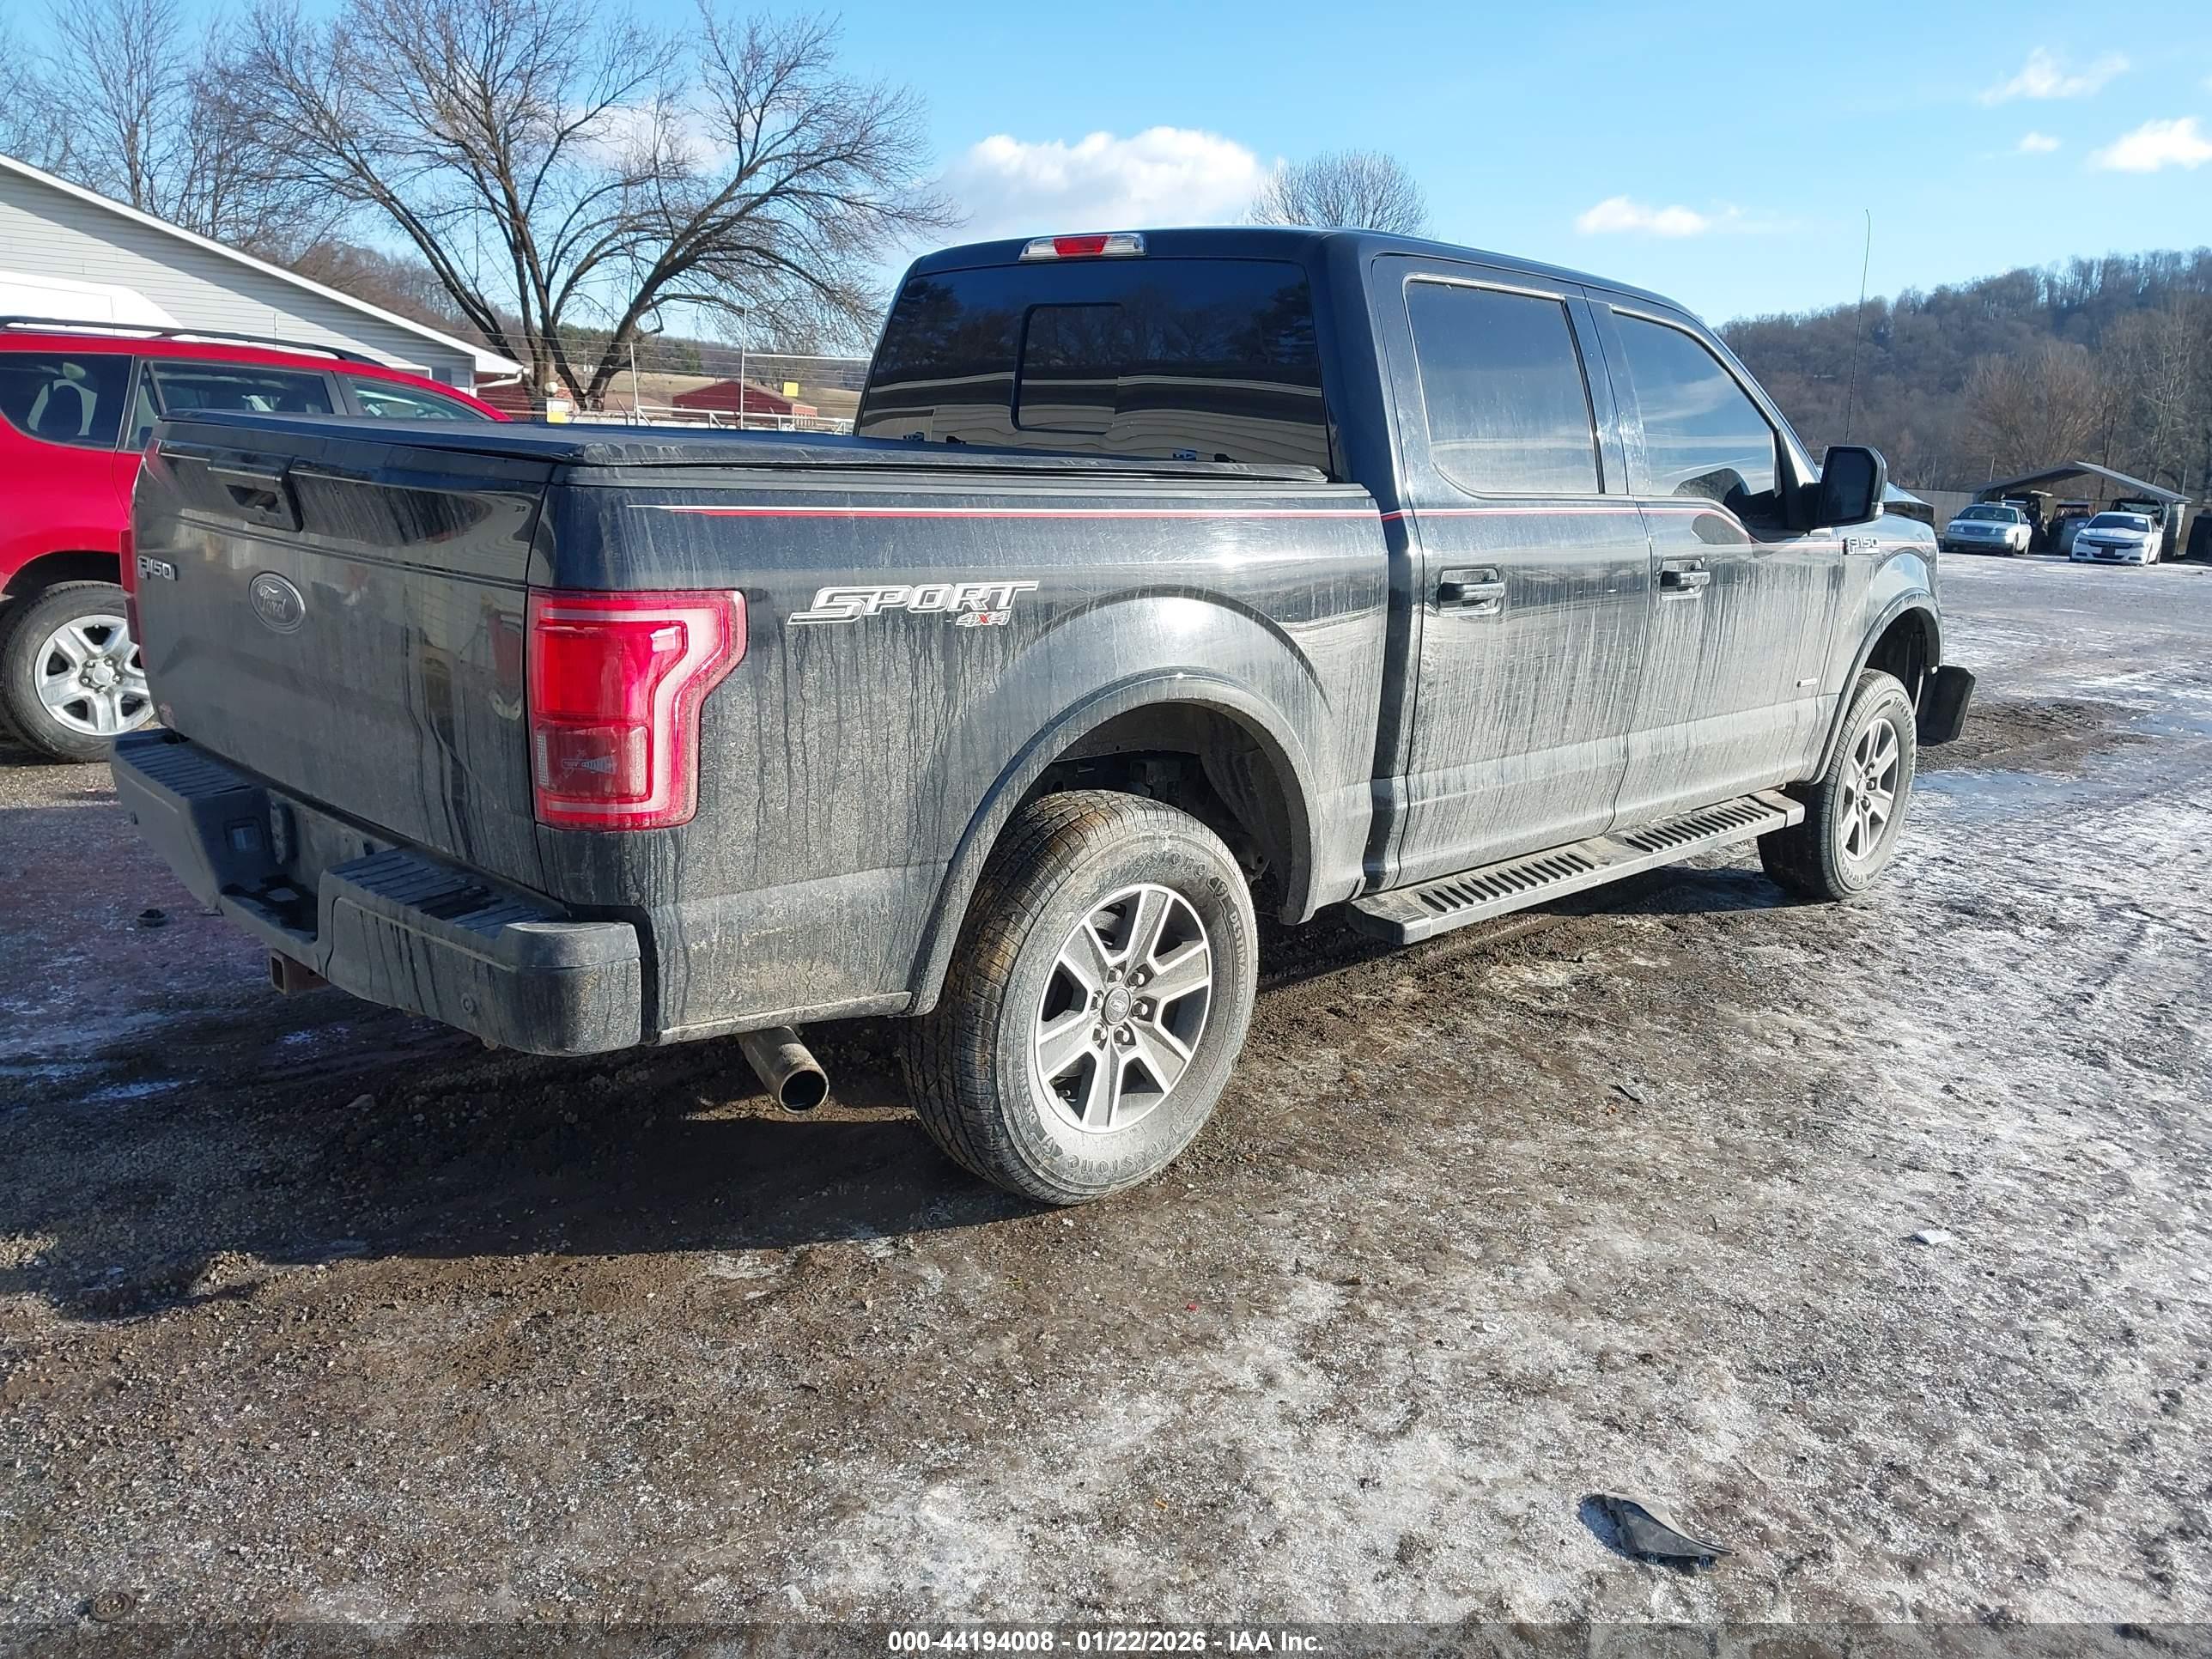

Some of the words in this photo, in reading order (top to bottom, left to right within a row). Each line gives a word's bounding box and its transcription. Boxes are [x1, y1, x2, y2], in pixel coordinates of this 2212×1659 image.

[256, 584, 288, 619] Ford
[787, 580, 1040, 626] SPORT
[1229, 911, 1248, 1013] DESTINATION
[1067, 1124, 1181, 1177] Firestone
